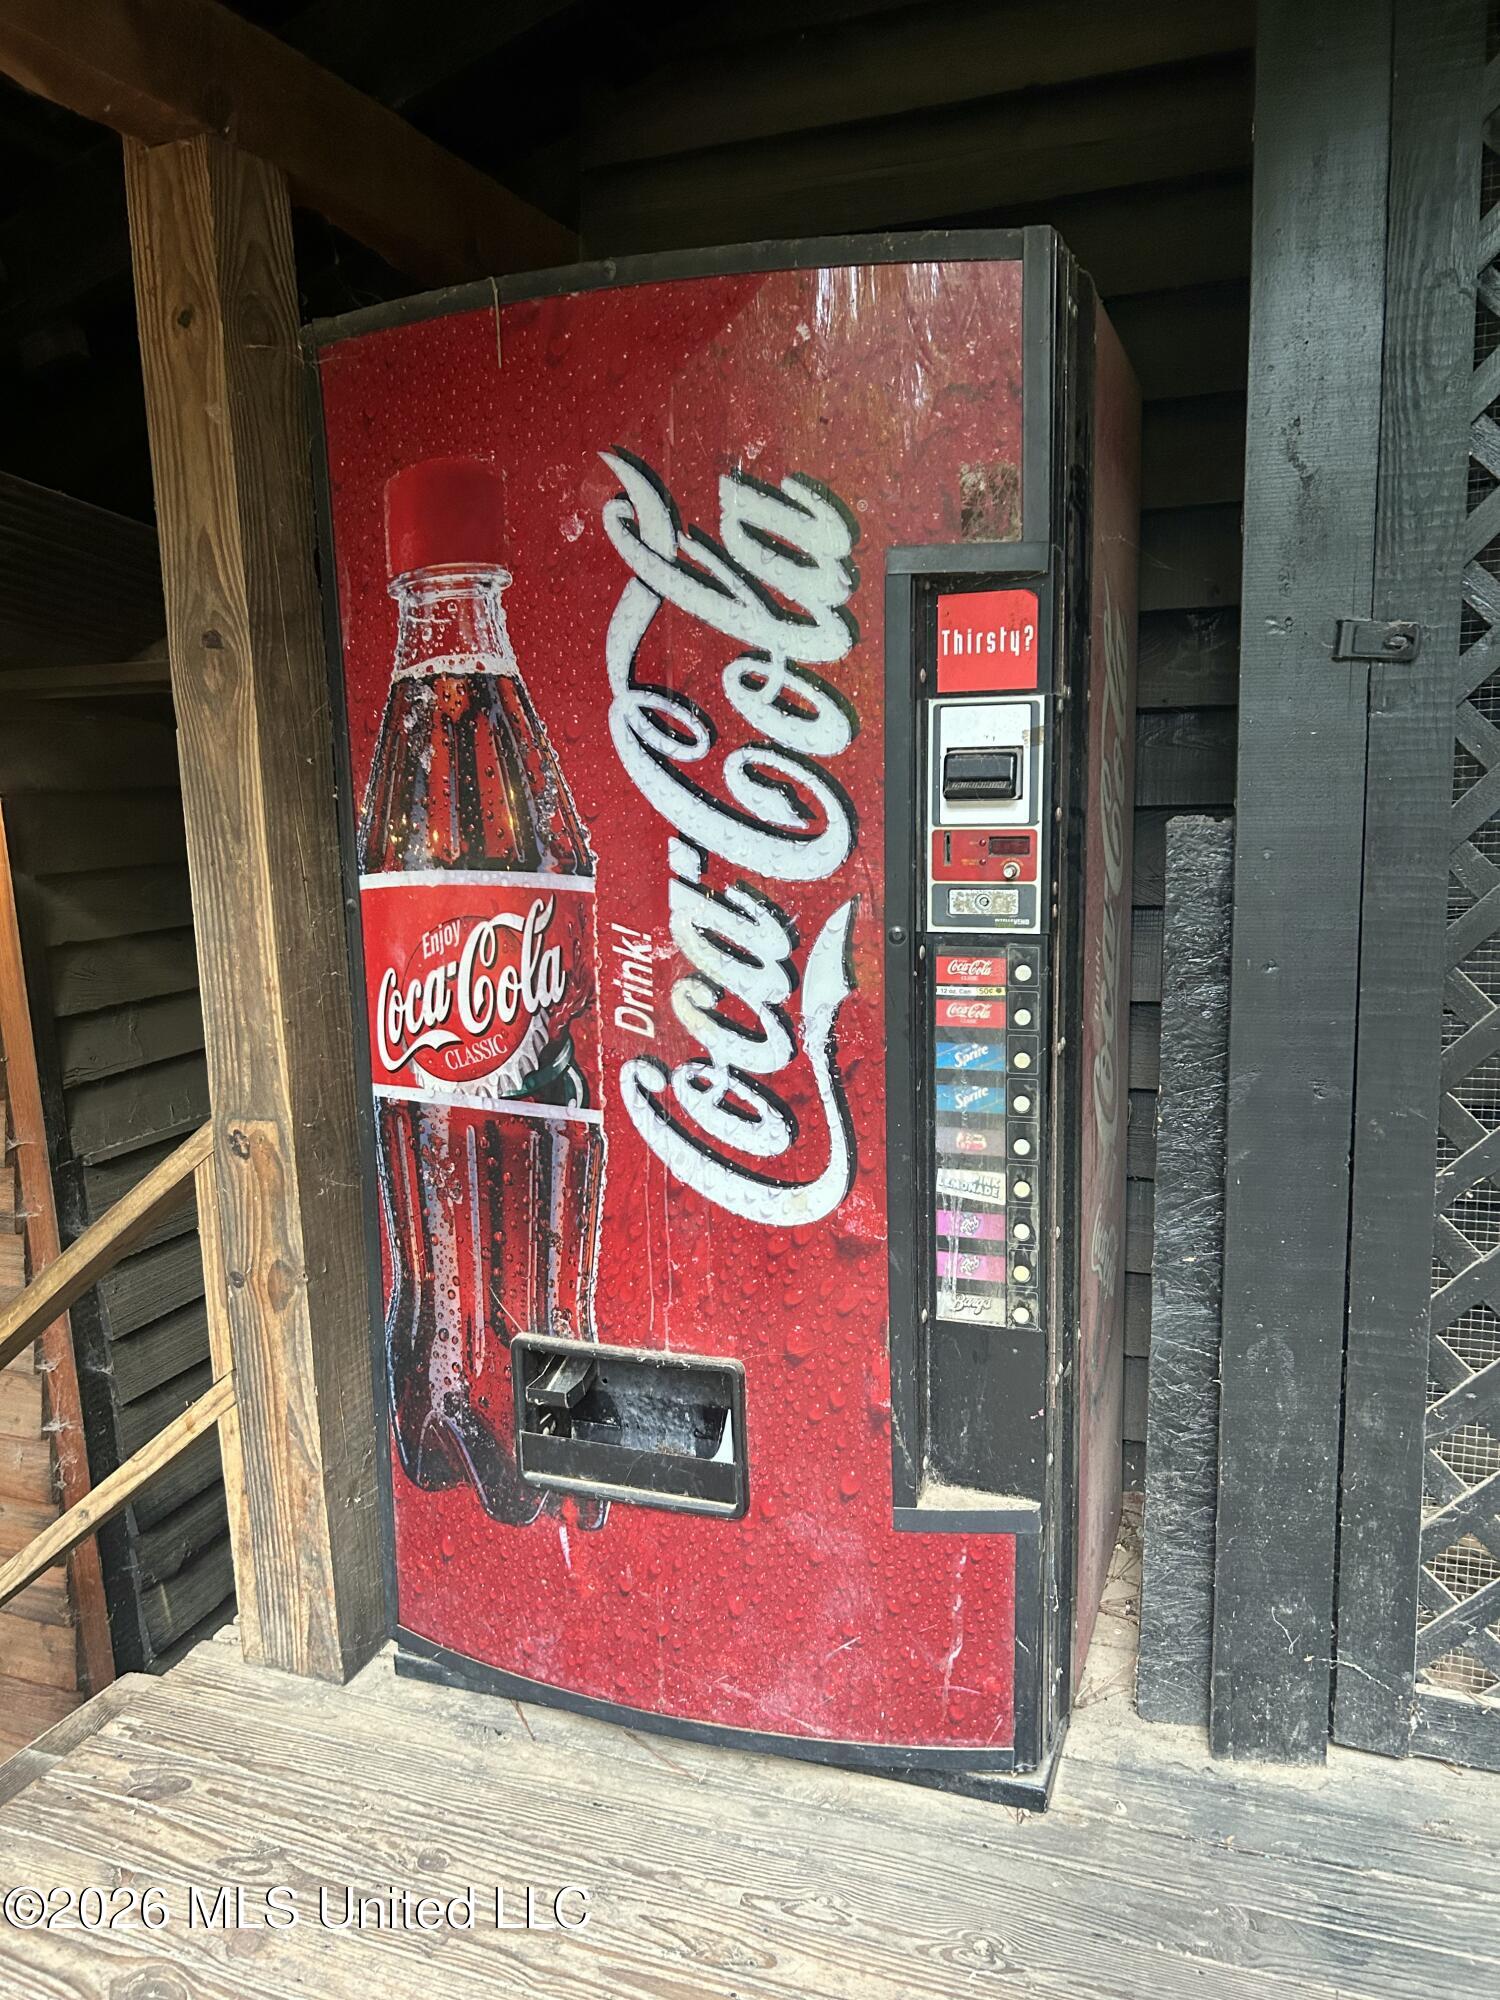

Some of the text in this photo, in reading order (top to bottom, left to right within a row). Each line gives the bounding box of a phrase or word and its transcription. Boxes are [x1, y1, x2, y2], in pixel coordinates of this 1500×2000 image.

[940, 624, 1035, 658] Thirsty?
[598, 450, 858, 1228] Coca-Cola
[421, 919, 462, 961] Enjoy
[376, 893, 566, 1073] Coca-Cola
[614, 923, 656, 1039] Drink!
[946, 959, 993, 976] Coca-Cola
[946, 1002, 992, 1019] Coca-Cola
[444, 1033, 508, 1072] CLASSIC
[954, 1043, 989, 1068] Sprite
[954, 1085, 989, 1110] Sprite
[938, 1175, 1000, 1199] LEMONADE
